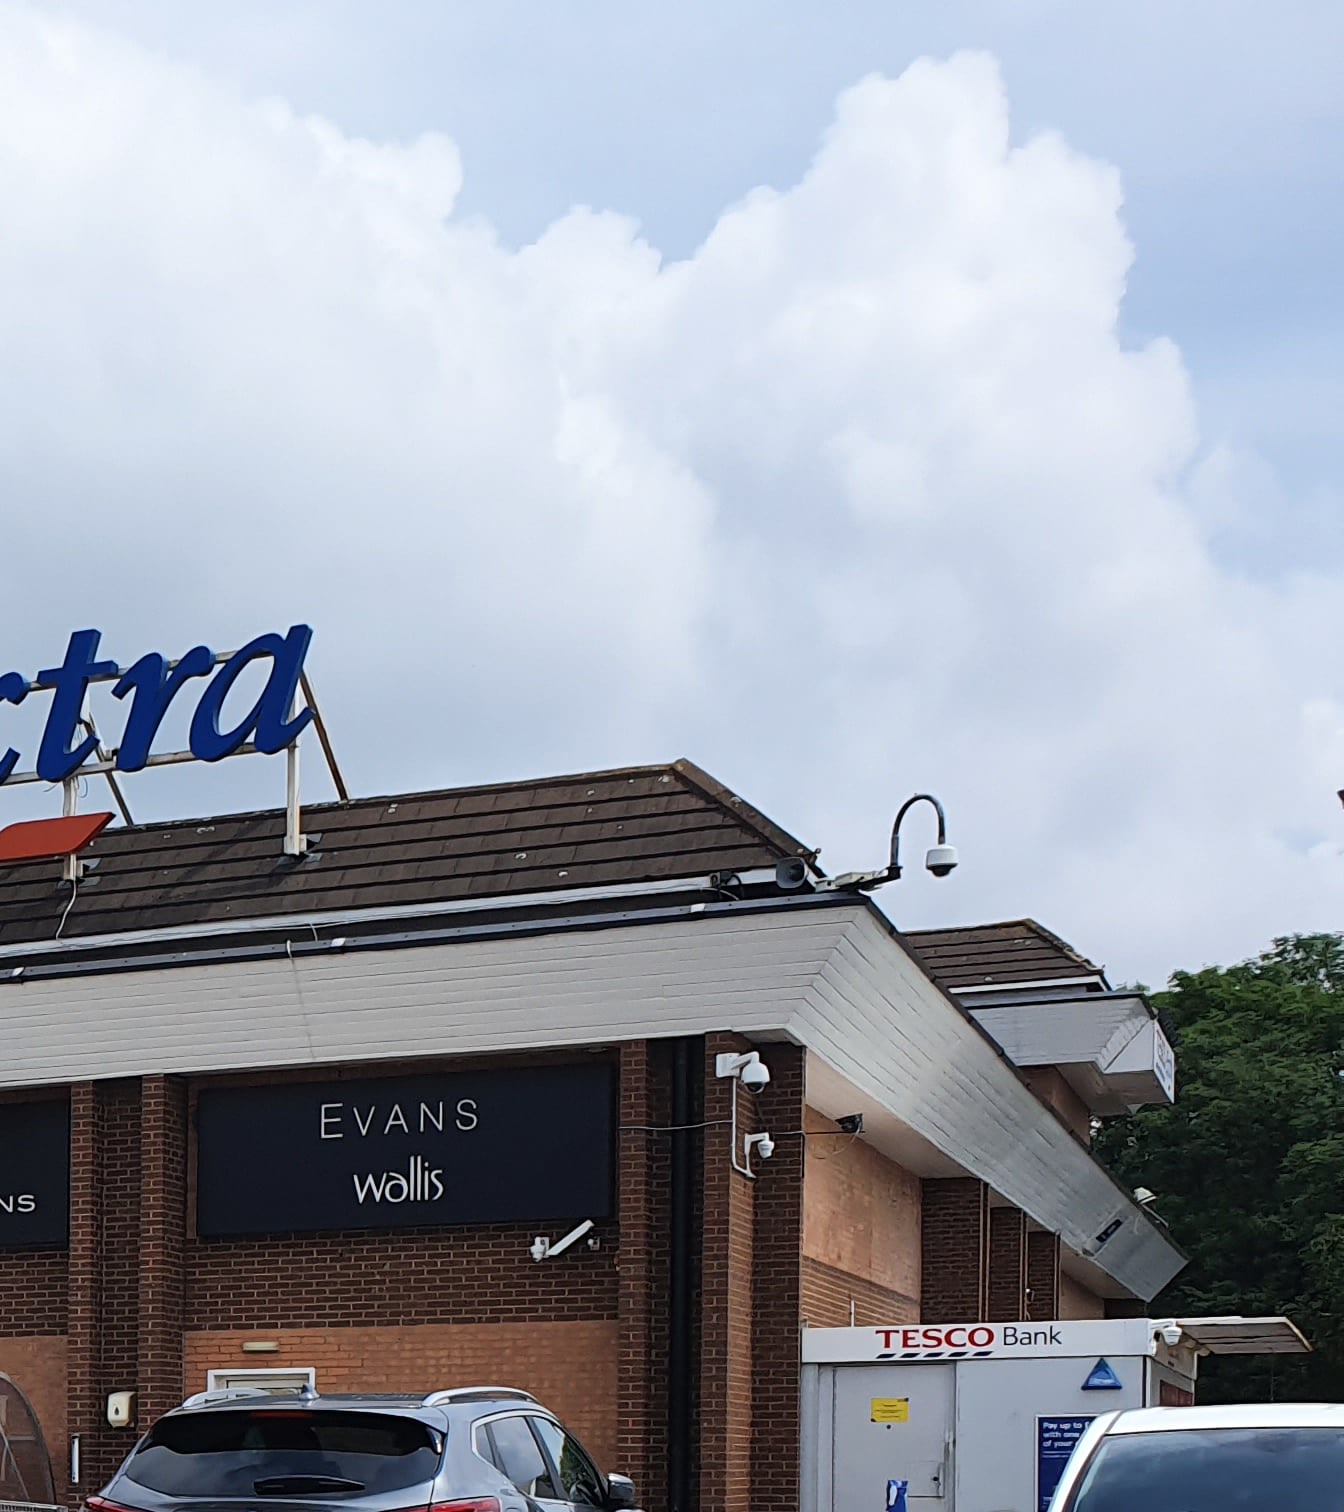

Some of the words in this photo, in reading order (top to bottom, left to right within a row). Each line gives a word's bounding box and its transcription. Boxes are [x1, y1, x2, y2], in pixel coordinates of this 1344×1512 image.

[320, 1099, 478, 1140] EVANS
[353, 1155, 444, 1204] wallis
[875, 1327, 994, 1349] TESCO
[1003, 1325, 1062, 1346] Bank
[1043, 1422, 1058, 1430] Pay
